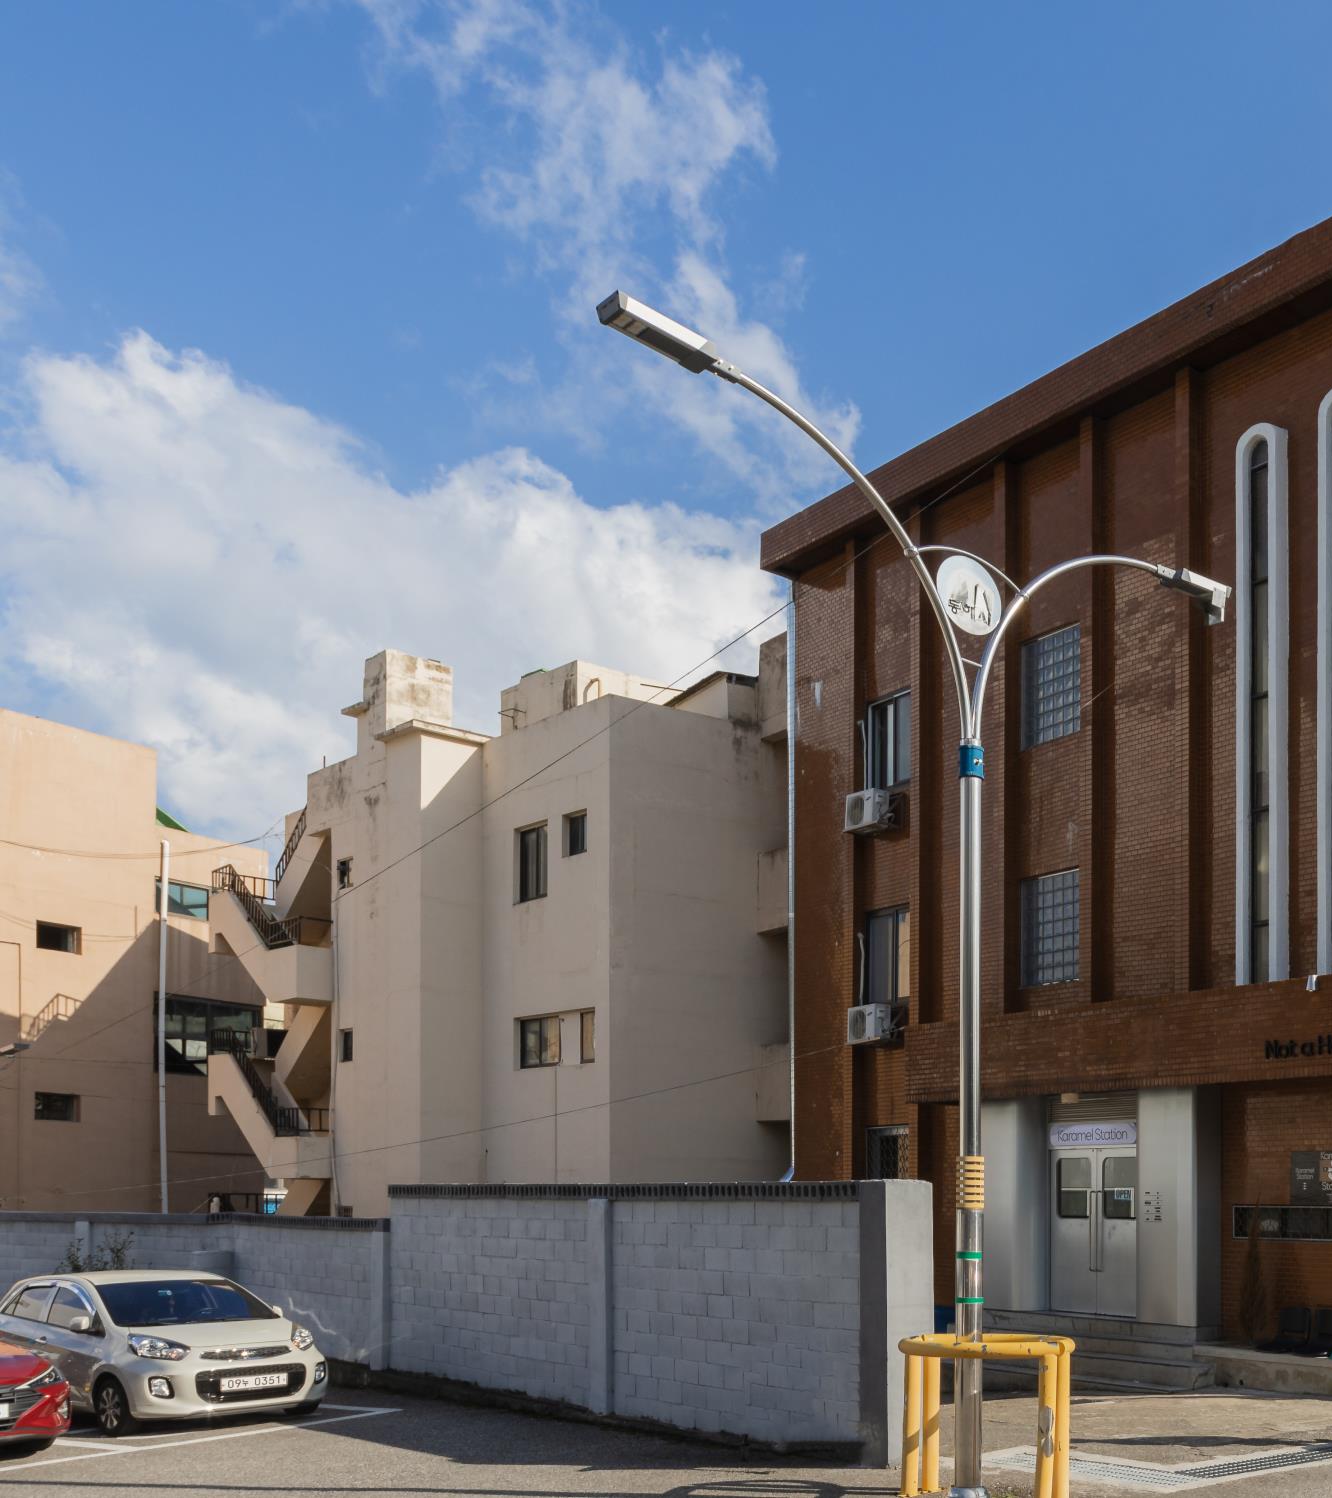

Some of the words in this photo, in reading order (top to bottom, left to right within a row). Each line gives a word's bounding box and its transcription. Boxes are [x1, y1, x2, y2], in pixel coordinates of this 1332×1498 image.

[1264, 1039, 1298, 1060] Not
[1301, 1041, 1315, 1057] a
[1057, 1129, 1094, 1142] Karamel
[1095, 1127, 1128, 1141] Station
[254, 1375, 281, 1386] 0351
